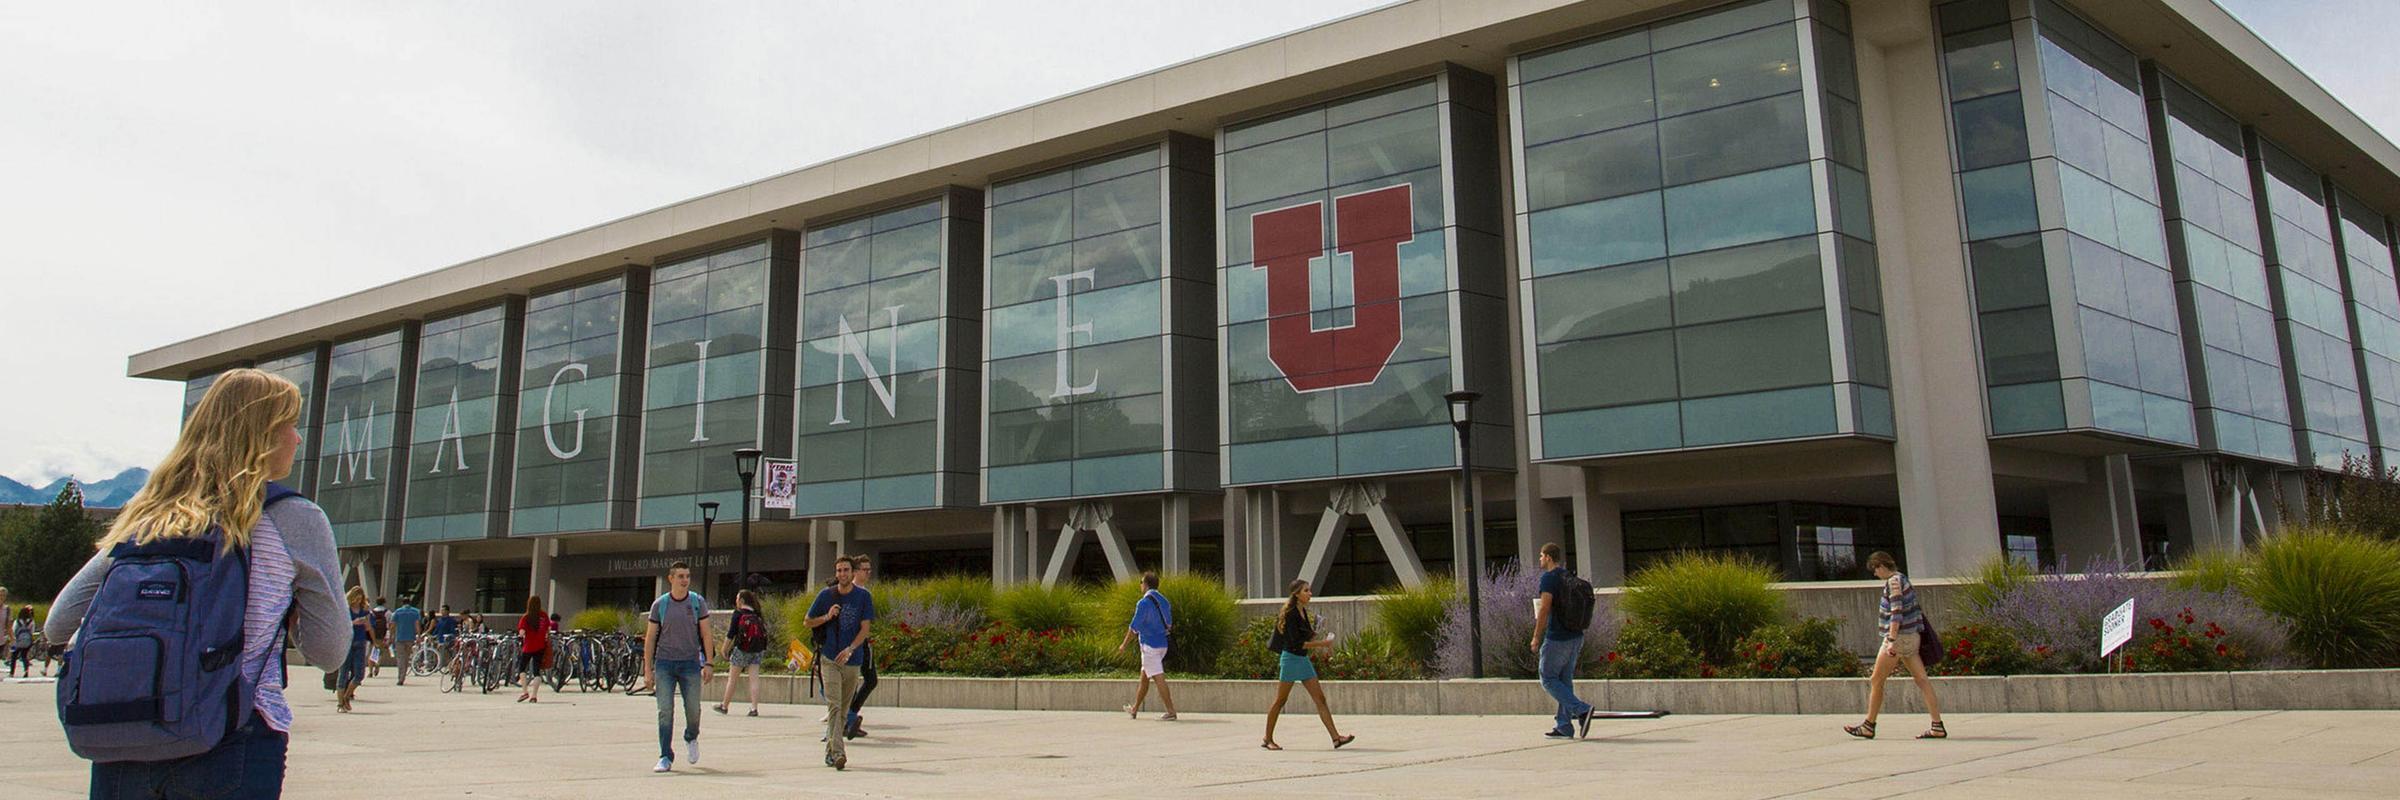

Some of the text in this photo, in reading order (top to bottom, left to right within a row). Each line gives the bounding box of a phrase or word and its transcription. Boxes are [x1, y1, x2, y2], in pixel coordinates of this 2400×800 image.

[1251, 182, 1414, 394] U
[614, 558, 649, 571] WILLARD
[694, 554, 730, 568] LIRARY
